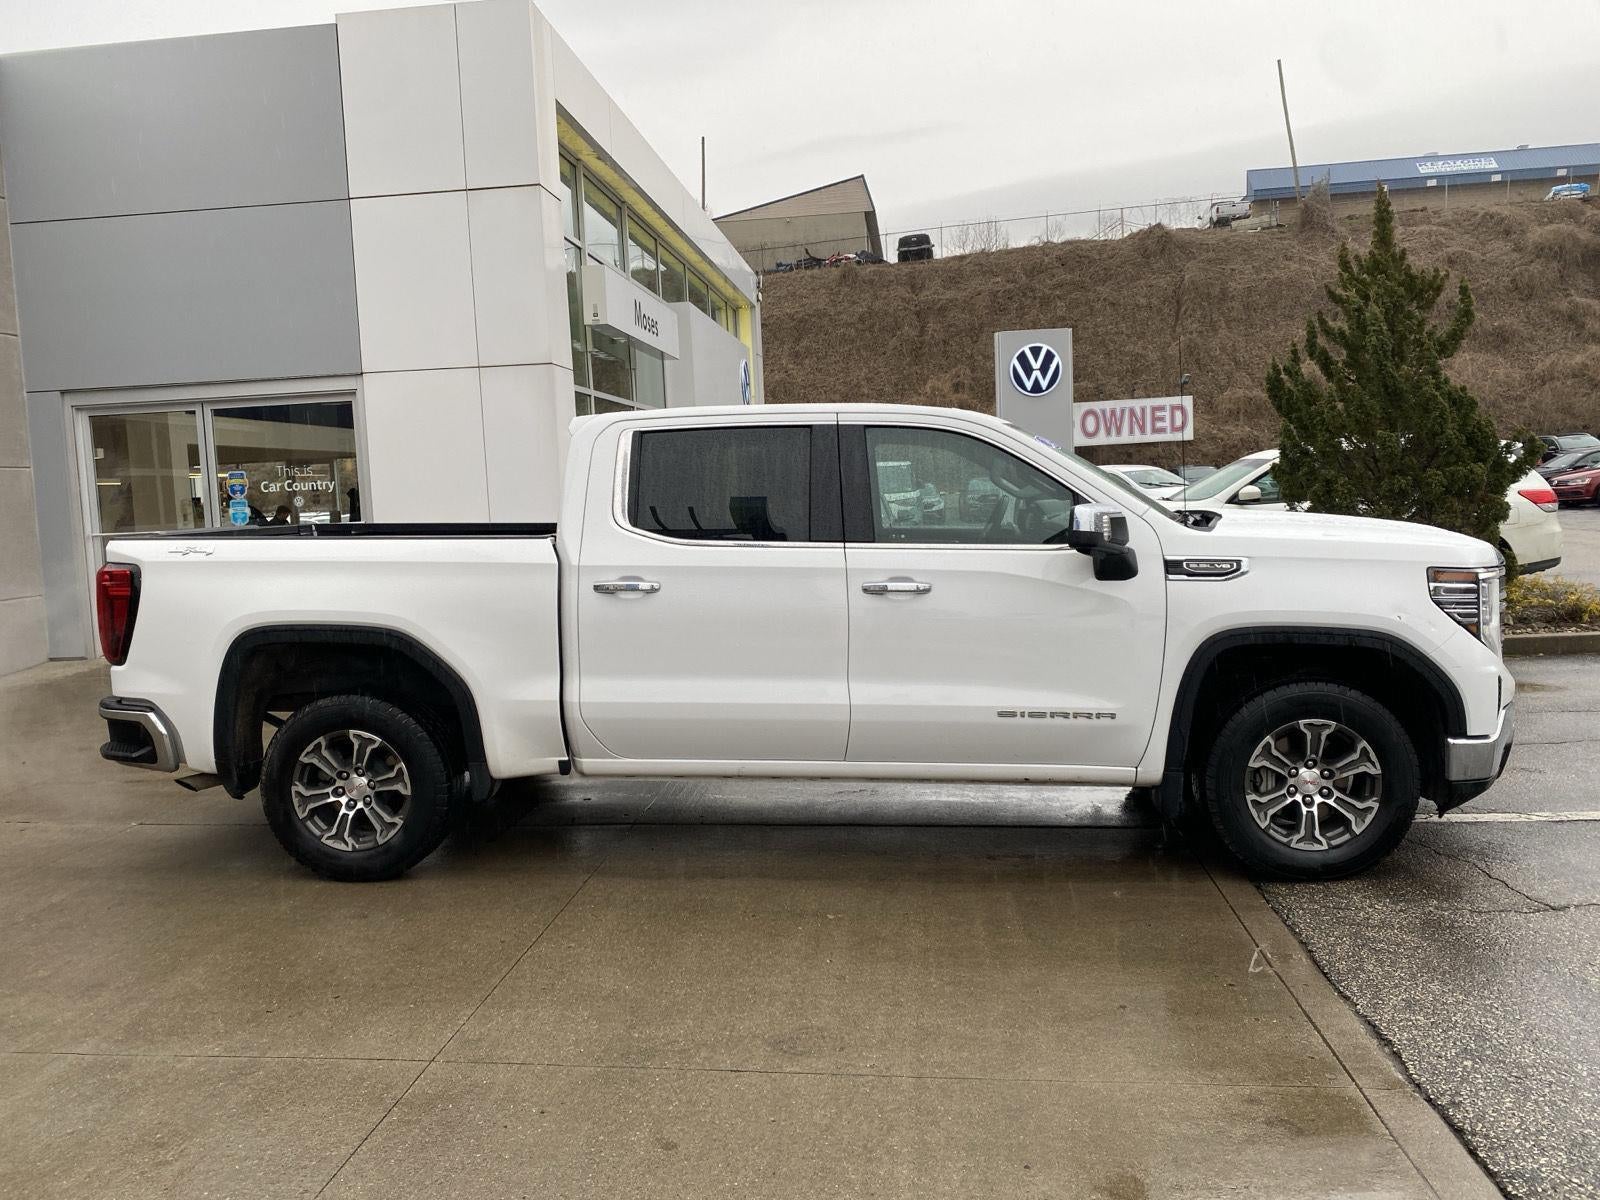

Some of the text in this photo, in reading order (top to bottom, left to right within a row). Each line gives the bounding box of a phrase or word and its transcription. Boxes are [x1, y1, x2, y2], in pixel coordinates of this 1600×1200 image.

[633, 298, 659, 337] Moses
[1079, 403, 1189, 440] OWNED
[275, 464, 313, 477] This is
[260, 480, 282, 494] Car
[284, 479, 335, 493] Country
[996, 710, 1117, 720] SIERRA
